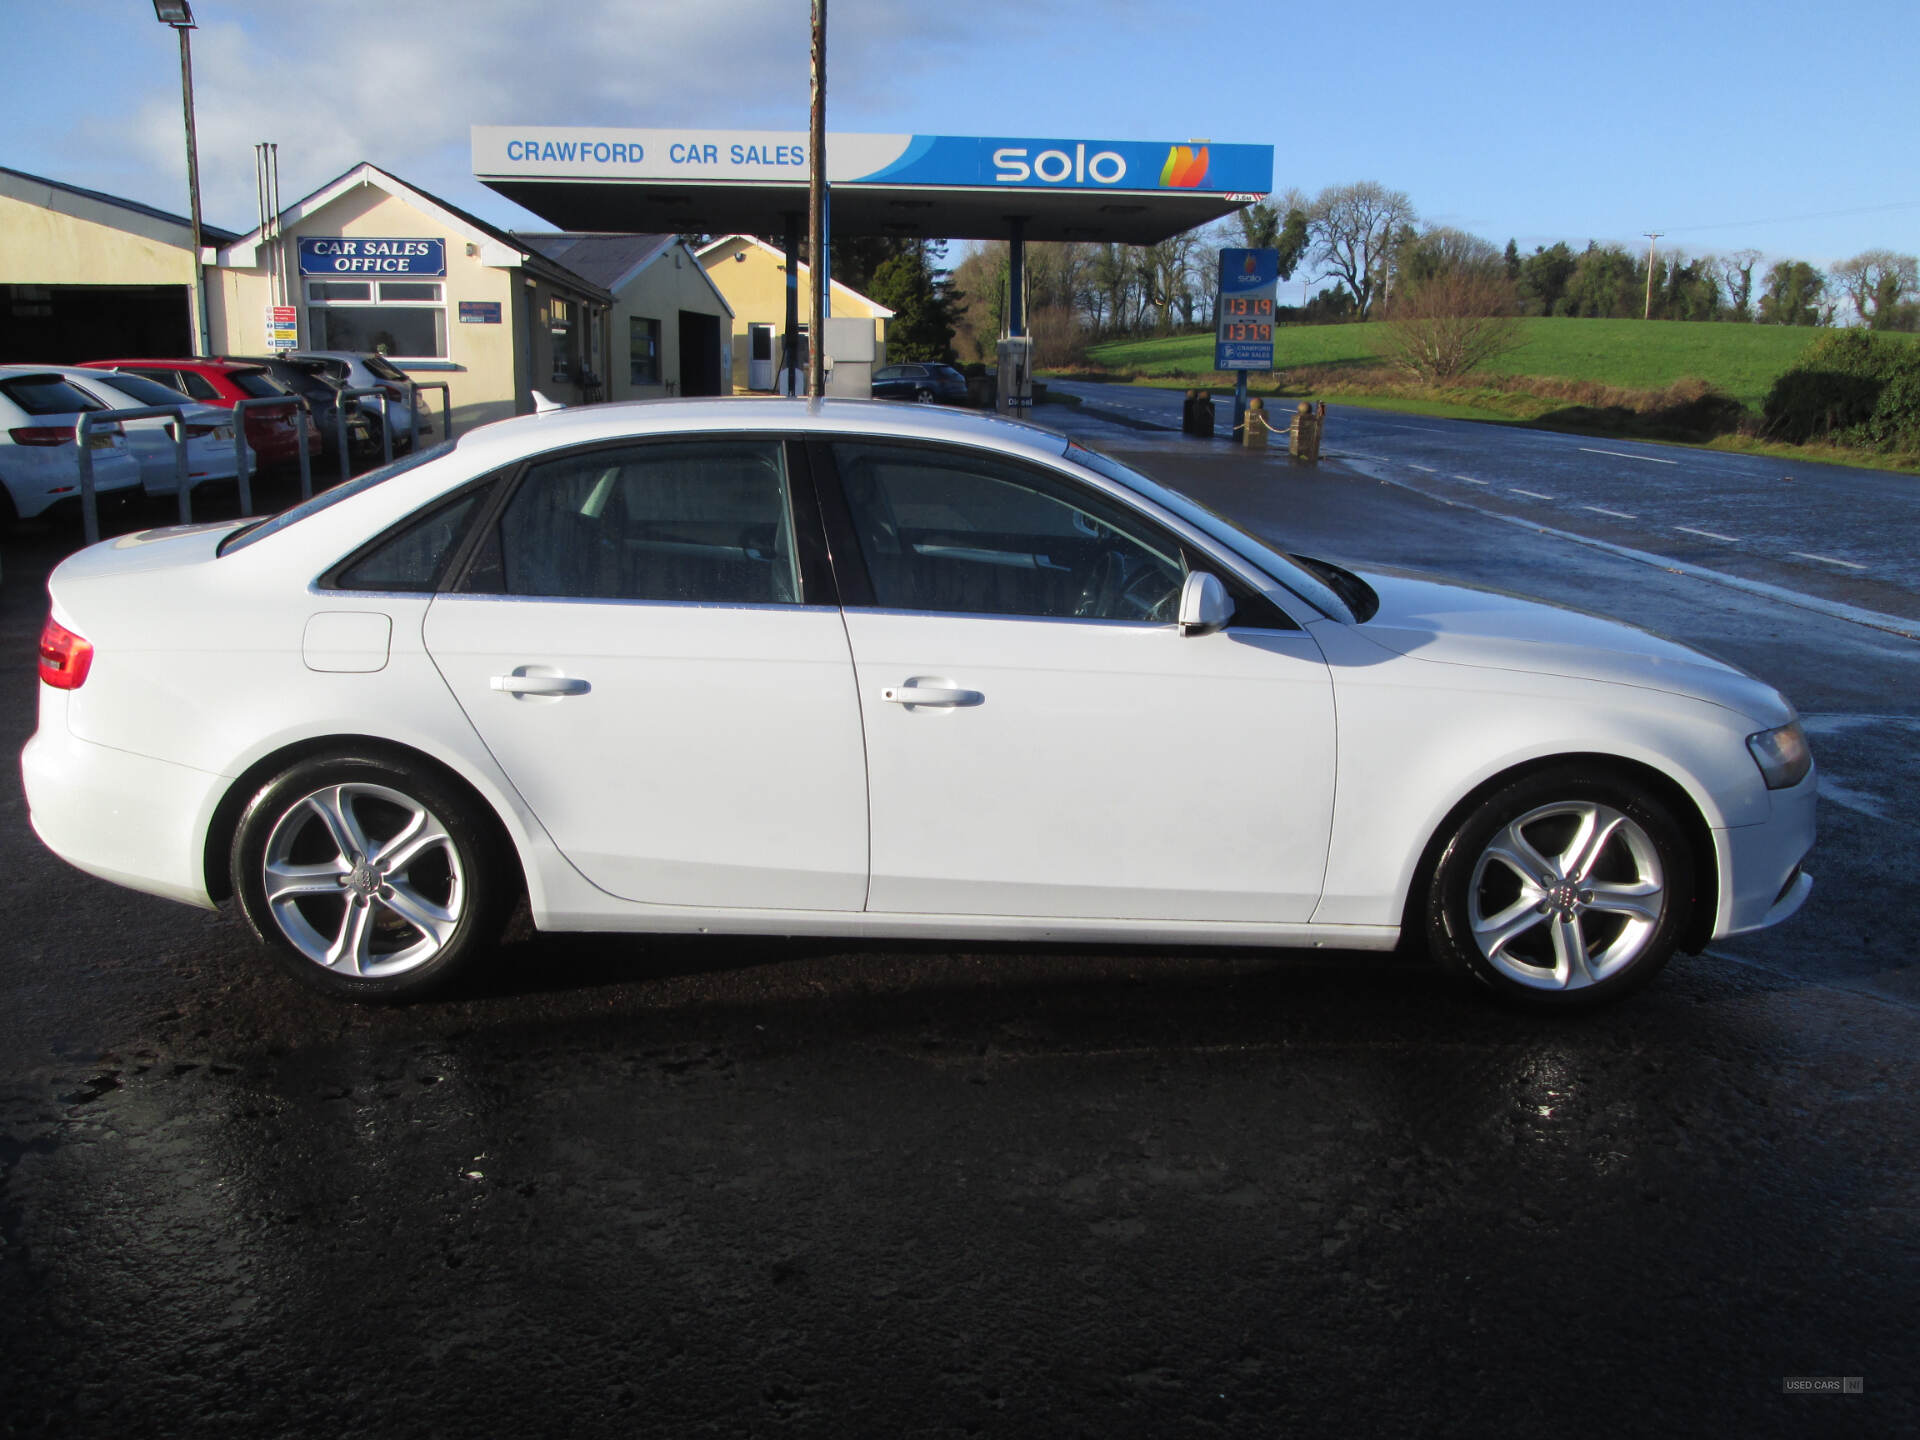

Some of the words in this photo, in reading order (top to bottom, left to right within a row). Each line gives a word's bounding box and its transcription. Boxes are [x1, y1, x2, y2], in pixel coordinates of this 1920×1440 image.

[507, 140, 644, 163] CRAWFORD
[669, 143, 718, 164] CAR
[730, 144, 804, 166] SALES
[992, 144, 1127, 184] solo
[313, 242, 357, 256] CAR
[363, 242, 429, 256] SALES
[334, 258, 410, 272] OFFICE
